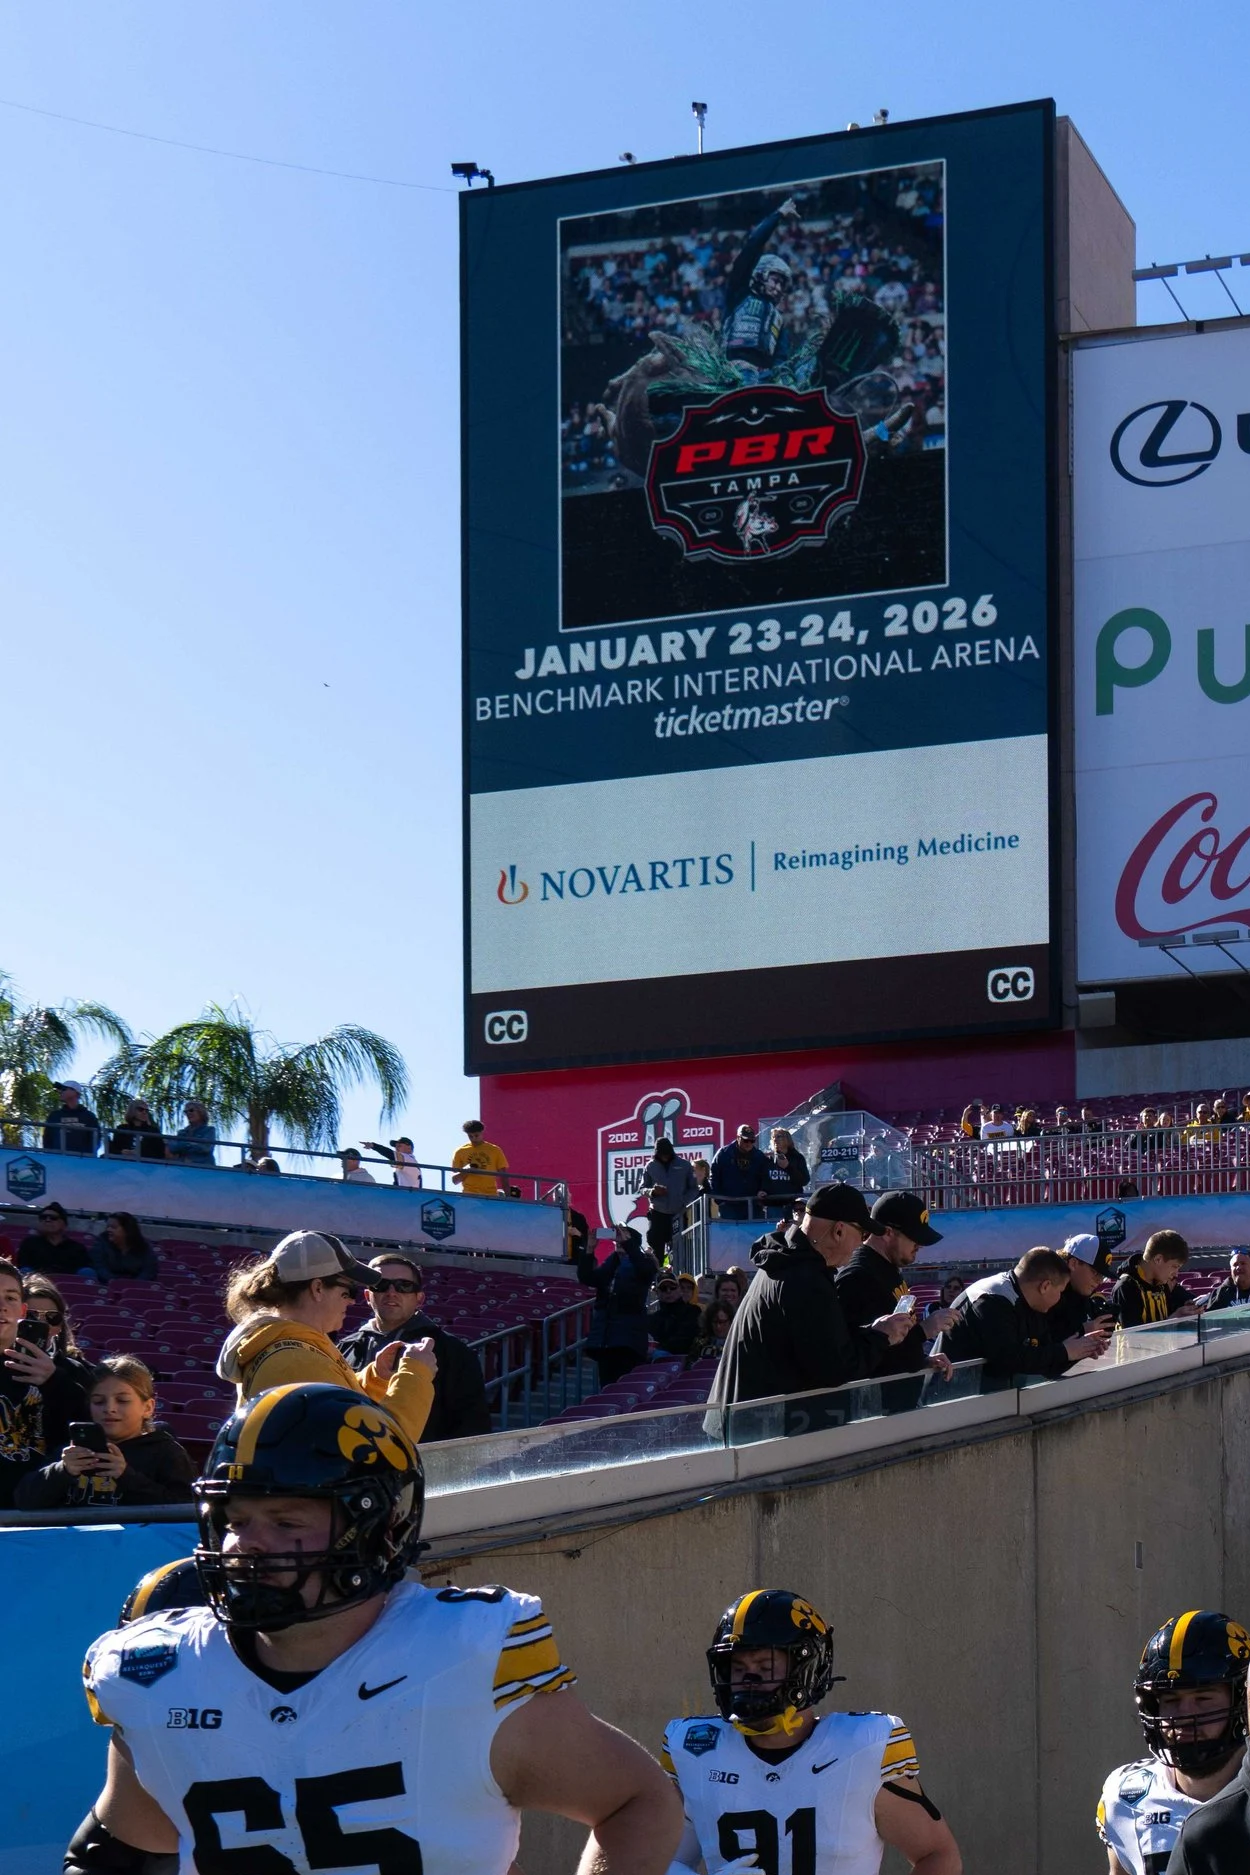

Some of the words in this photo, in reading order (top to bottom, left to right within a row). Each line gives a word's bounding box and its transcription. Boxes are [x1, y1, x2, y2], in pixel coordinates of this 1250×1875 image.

[675, 426, 836, 473] PBR
[710, 473, 800, 494] TAMPA
[515, 626, 716, 680] JANUARY
[728, 611, 869, 655] 23-24,
[883, 594, 998, 637] 2026
[475, 677, 663, 721] BENCHMARK
[674, 649, 922, 699] INTERNATIONAL
[931, 635, 1040, 670] ARENA
[654, 696, 840, 738] ticketmaster
[540, 853, 734, 901] NOVARTIS
[773, 843, 909, 871] Reimagining
[916, 831, 1020, 858] Medicine
[990, 971, 1032, 999] CC
[487, 1015, 525, 1041] CC
[608, 1133, 639, 1143] 2002
[683, 1127, 713, 1138] 2020
[615, 1155, 656, 1169] SUPE
[822, 1147, 858, 1157] 220-219
